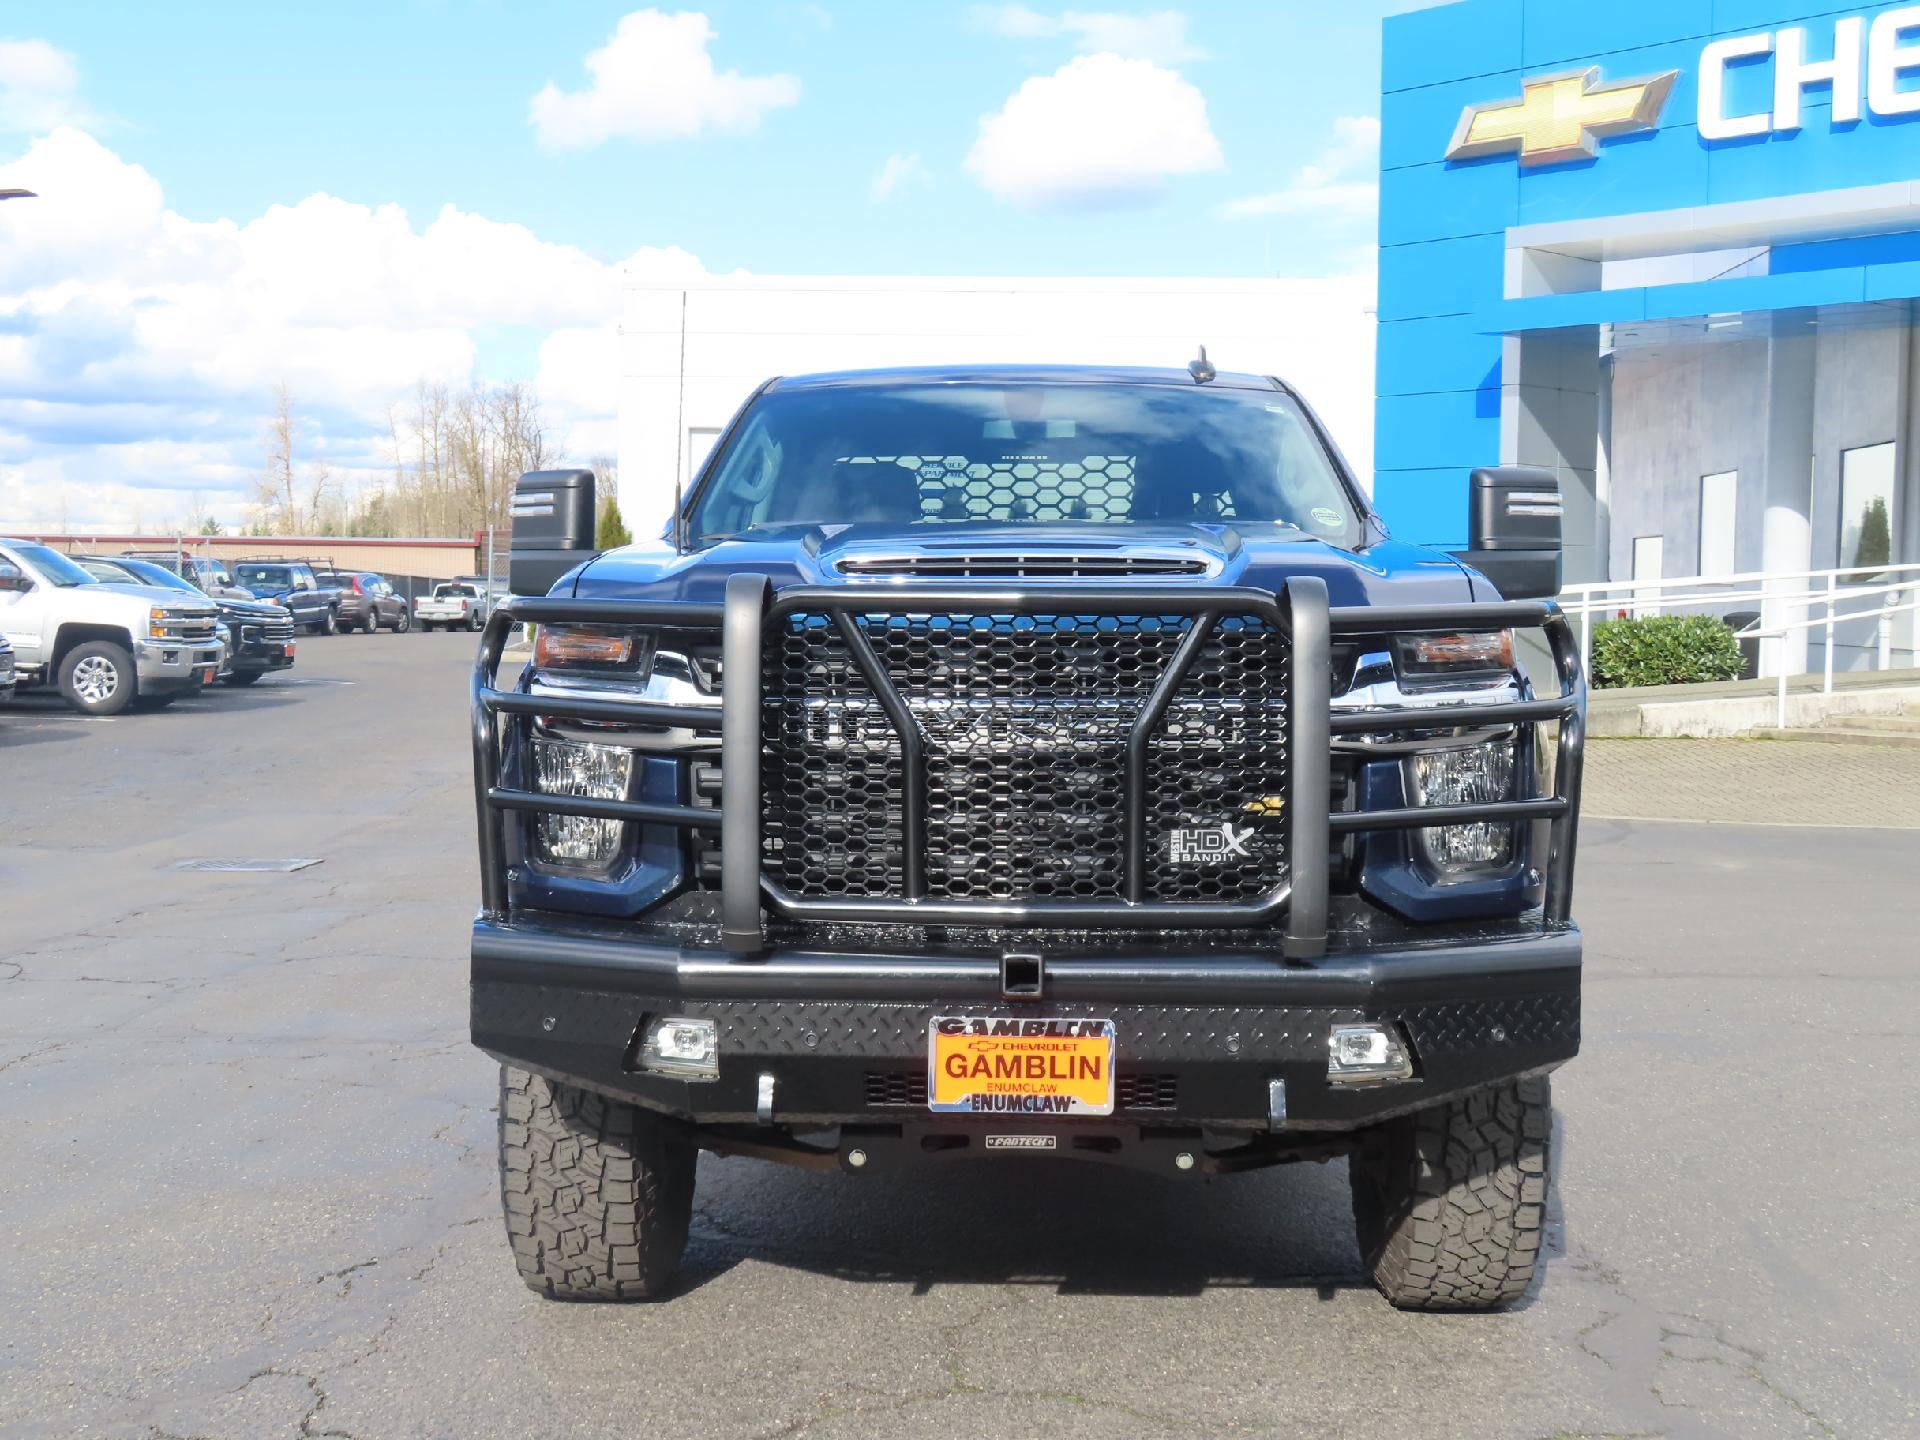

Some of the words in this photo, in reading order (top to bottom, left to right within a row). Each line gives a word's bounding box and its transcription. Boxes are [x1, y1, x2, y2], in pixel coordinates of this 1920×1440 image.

[1697, 4, 1920, 140] CHE
[1180, 822, 1255, 856] HDX
[1182, 853, 1236, 862] BANDIT
[937, 1018, 1106, 1037] GAMBLIN
[1002, 1043, 1079, 1052] CHEVROLET
[945, 1053, 1101, 1080] GAMBLIN
[986, 1083, 1058, 1093] ENUMCLAW
[971, 1093, 1072, 1113] ENUMCLAW
